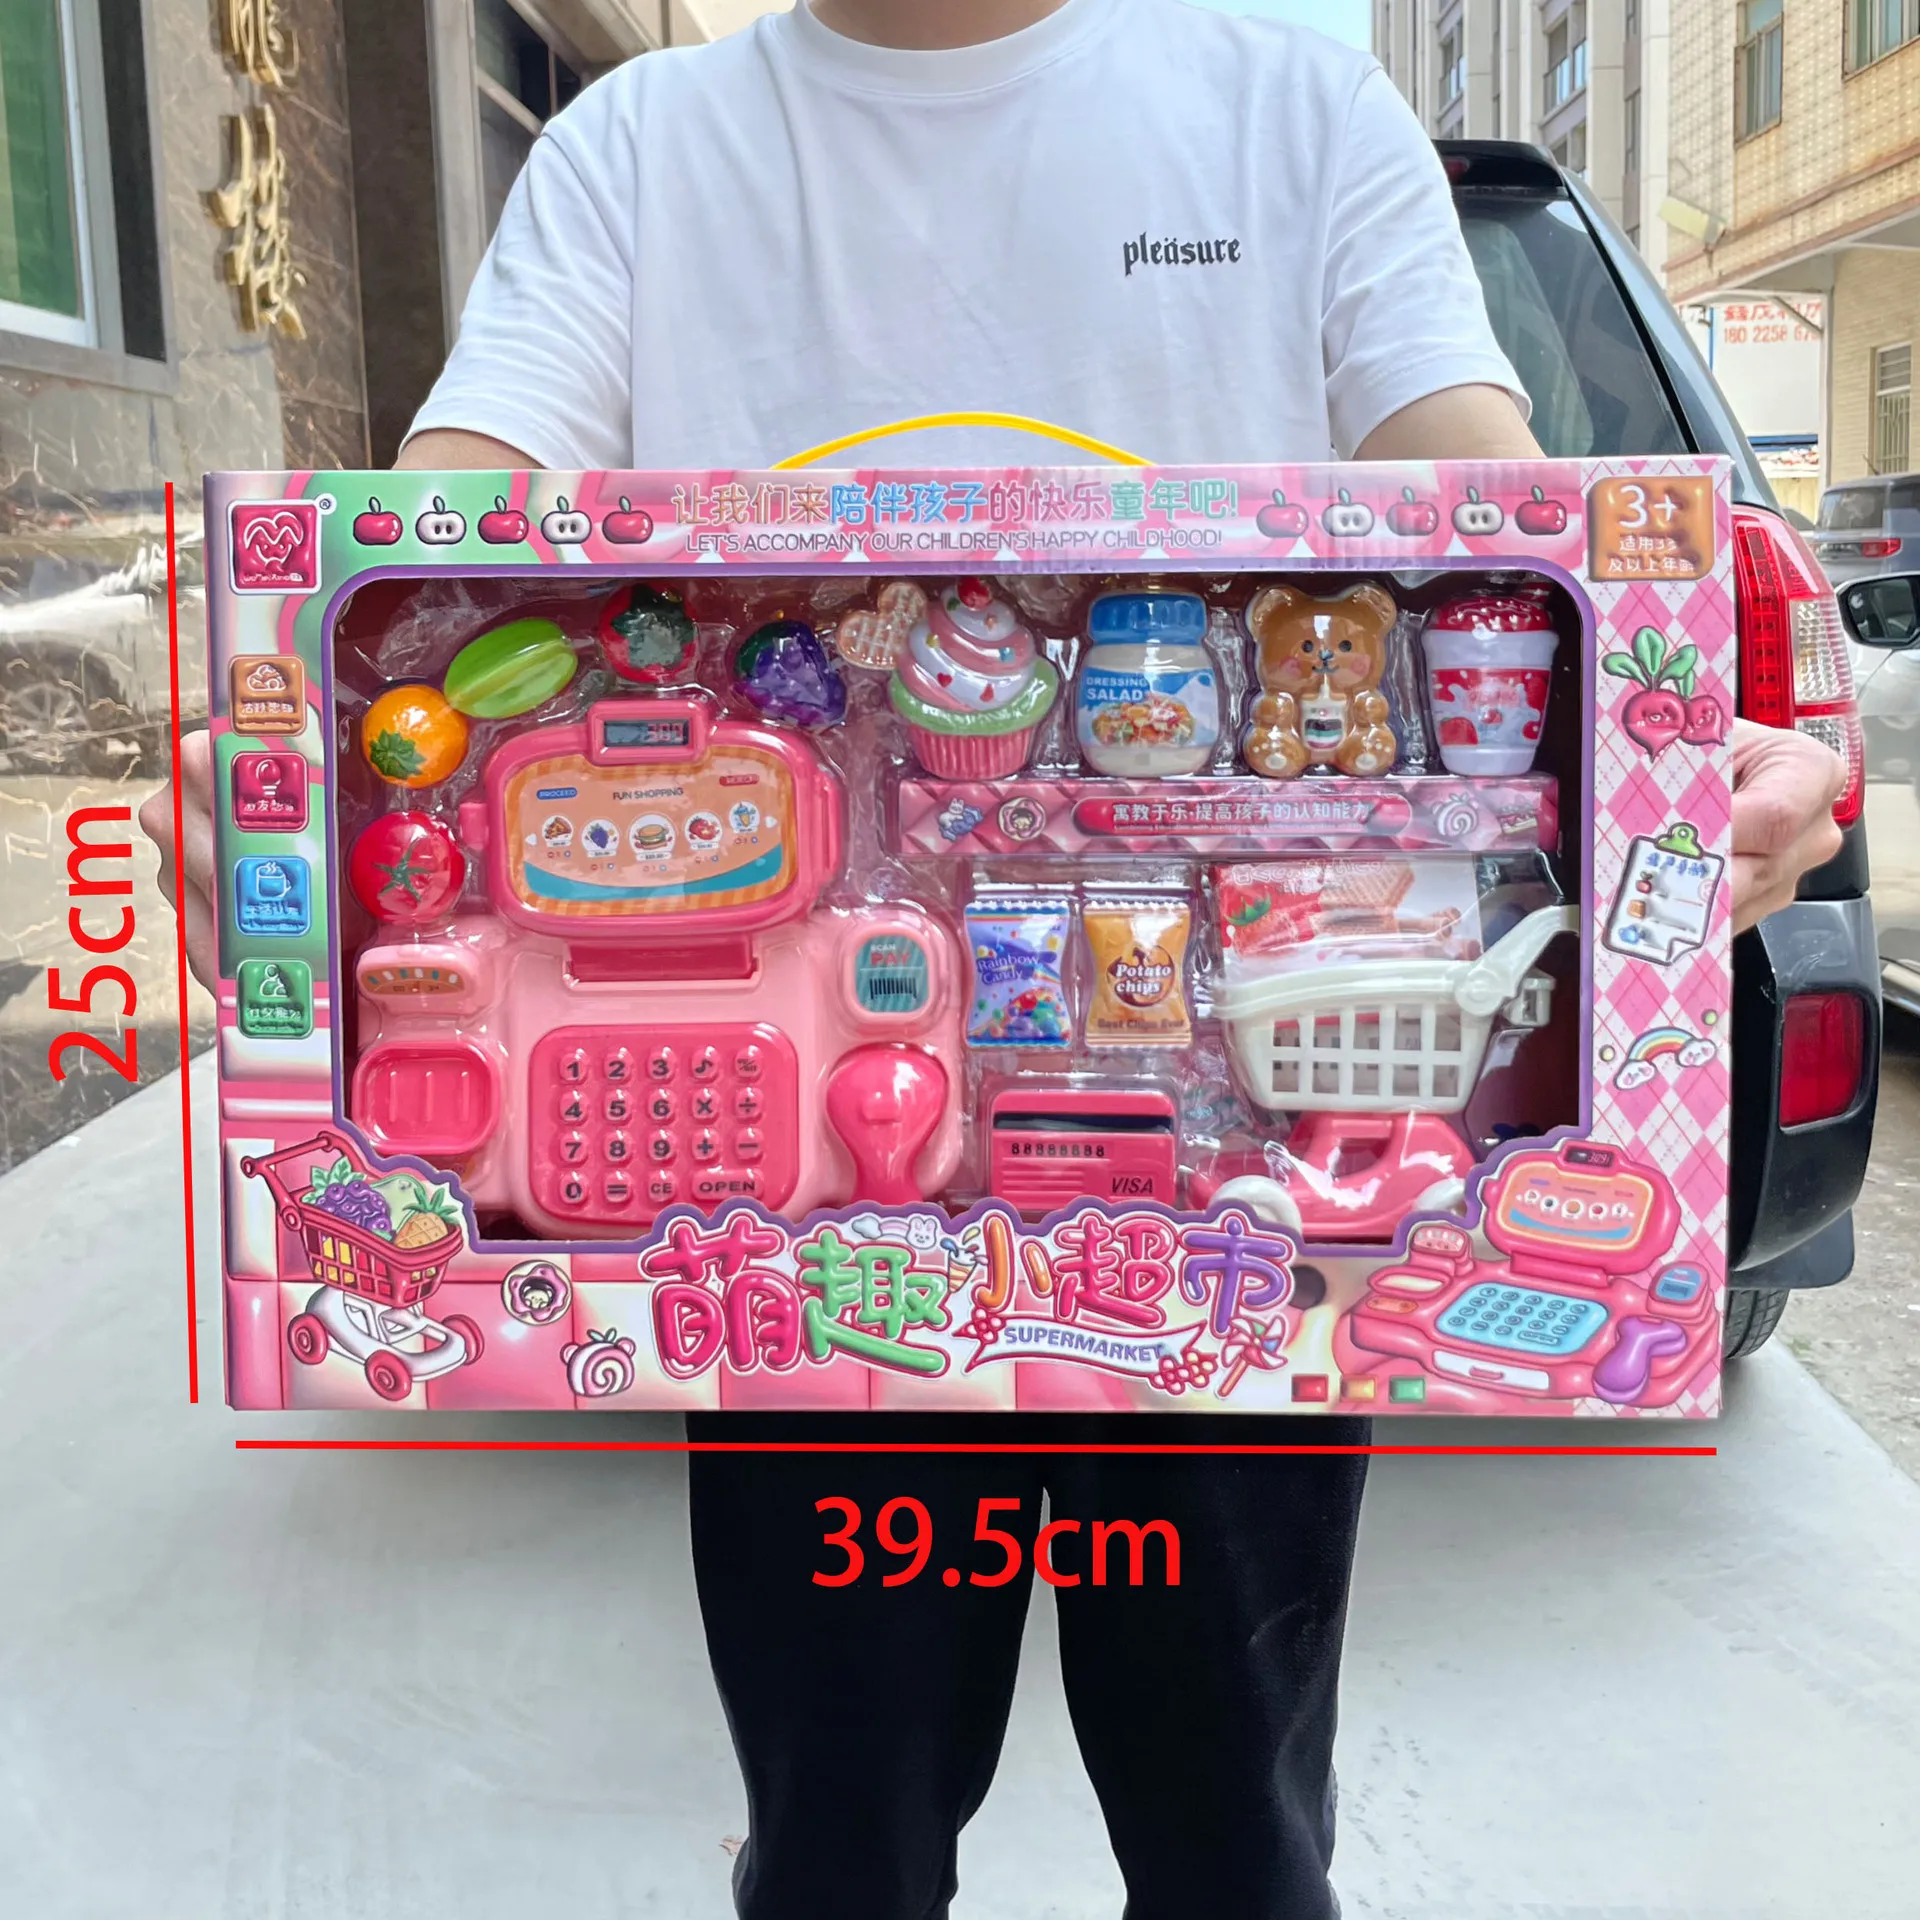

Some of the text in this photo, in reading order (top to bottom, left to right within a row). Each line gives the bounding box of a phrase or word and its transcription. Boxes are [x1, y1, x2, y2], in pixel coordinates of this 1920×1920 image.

[1123, 231, 1241, 277] pleäsure
[1724, 327, 1748, 343] 180
[1753, 325, 1788, 343] 2258
[672, 480, 1239, 524] 让我们来陪伴孩子的快乐童年吧!
[1618, 485, 1678, 529] 3+
[686, 532, 740, 552] LET'S
[743, 531, 868, 551] ACCOMPANY
[871, 530, 913, 551] OUR
[1031, 529, 1098, 550] HAPPY
[1102, 528, 1222, 549] CHILDHOOD!
[1086, 677, 1149, 687] DRESSING
[1086, 688, 1144, 701] SALAD
[612, 787, 684, 801] FUN SHOPPING
[870, 951, 911, 966] PAY
[977, 953, 1039, 971] Rainbow
[982, 967, 1023, 983] Candy
[1115, 962, 1172, 978] Potato
[566, 1059, 669, 1078] 1 2 3
[564, 1102, 583, 1119] 4
[609, 1100, 627, 1117] 5
[653, 1100, 670, 1117] 6
[565, 1142, 582, 1159] 7
[609, 1140, 627, 1158] 8
[653, 1139, 671, 1157] 9
[565, 1182, 583, 1199] 0
[650, 1183, 673, 1195] CE
[699, 1181, 756, 1193] OPEN
[1110, 1177, 1154, 1195] VISA
[642, 1211, 1293, 1377] 萌趣小超市
[1003, 1326, 1165, 1362] SUPERMARKET
